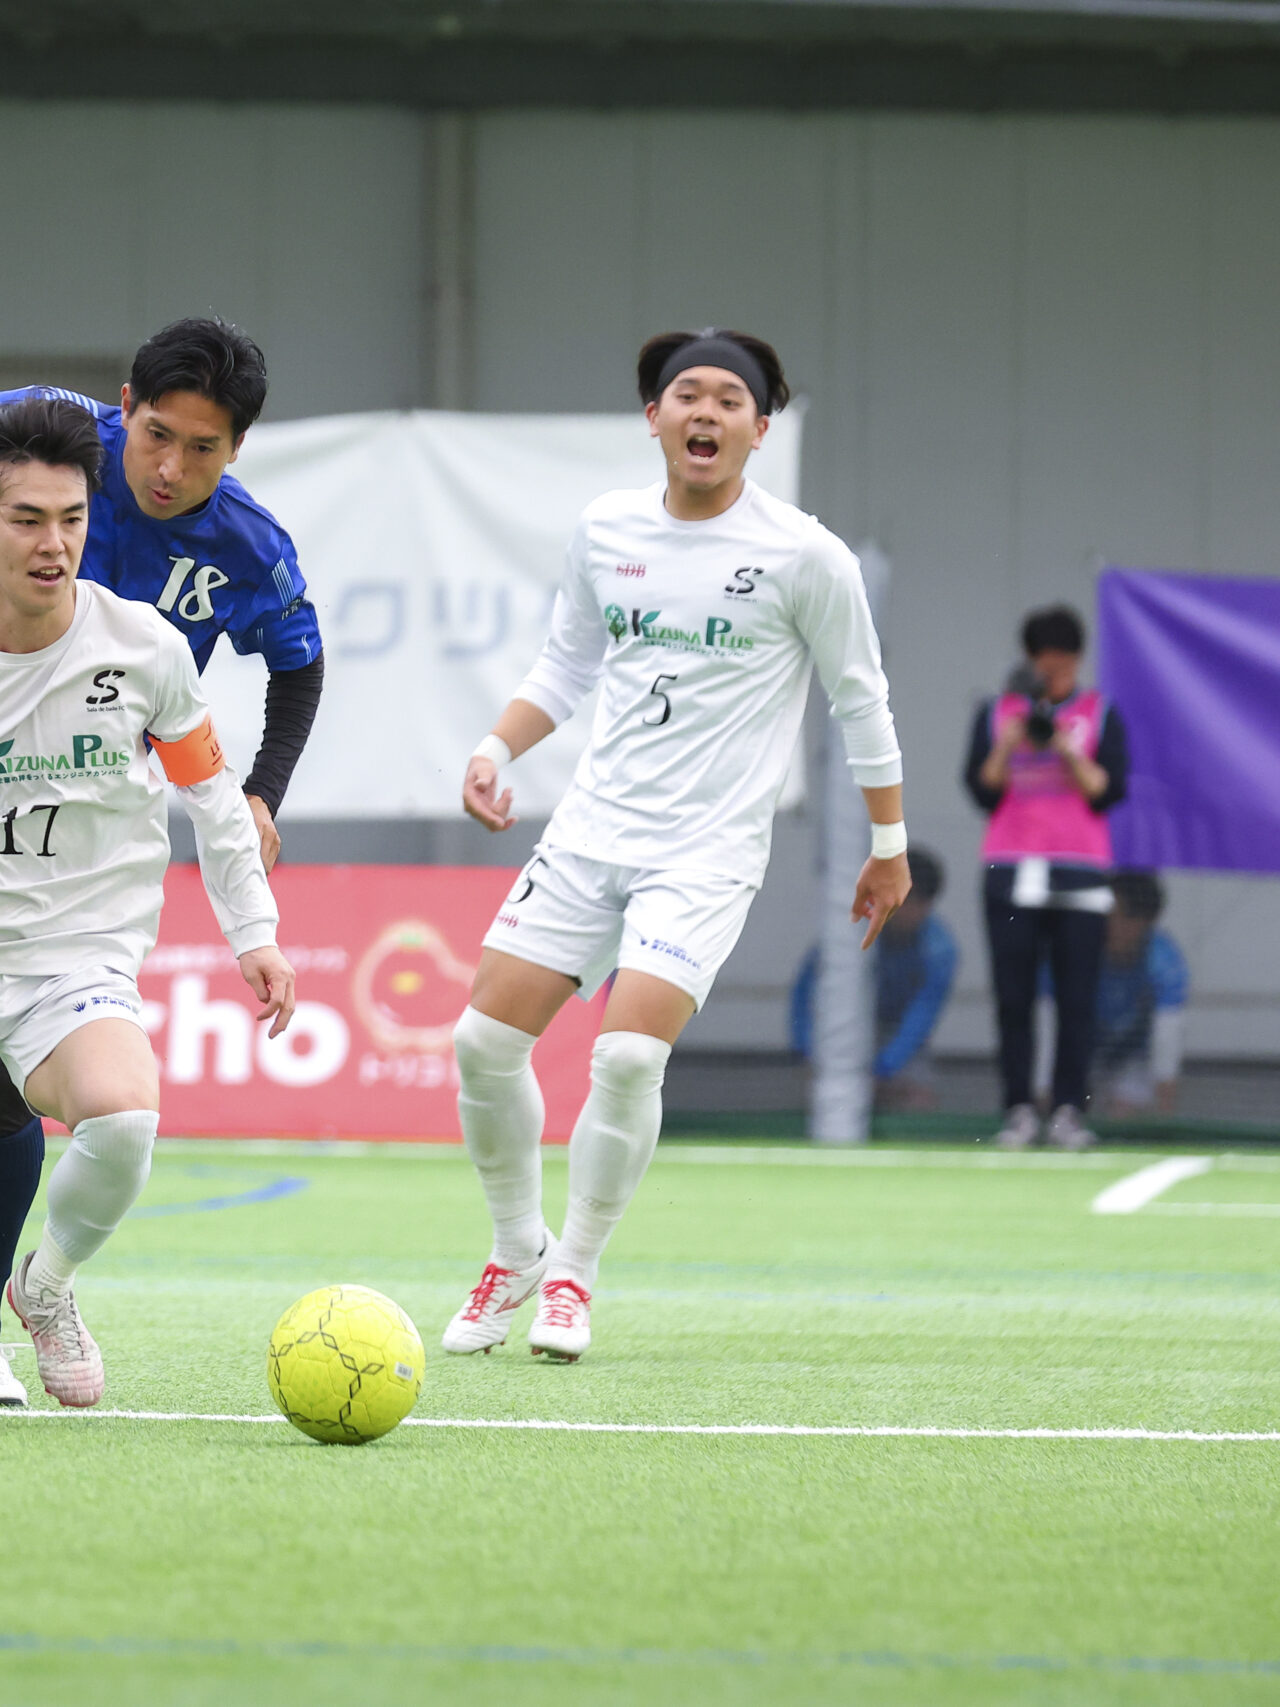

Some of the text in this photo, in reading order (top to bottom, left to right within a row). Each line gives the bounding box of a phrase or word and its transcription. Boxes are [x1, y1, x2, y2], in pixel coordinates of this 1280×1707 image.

[155, 555, 230, 622] 18
[642, 673, 678, 725] 5
[72, 734, 130, 769] PLUS
